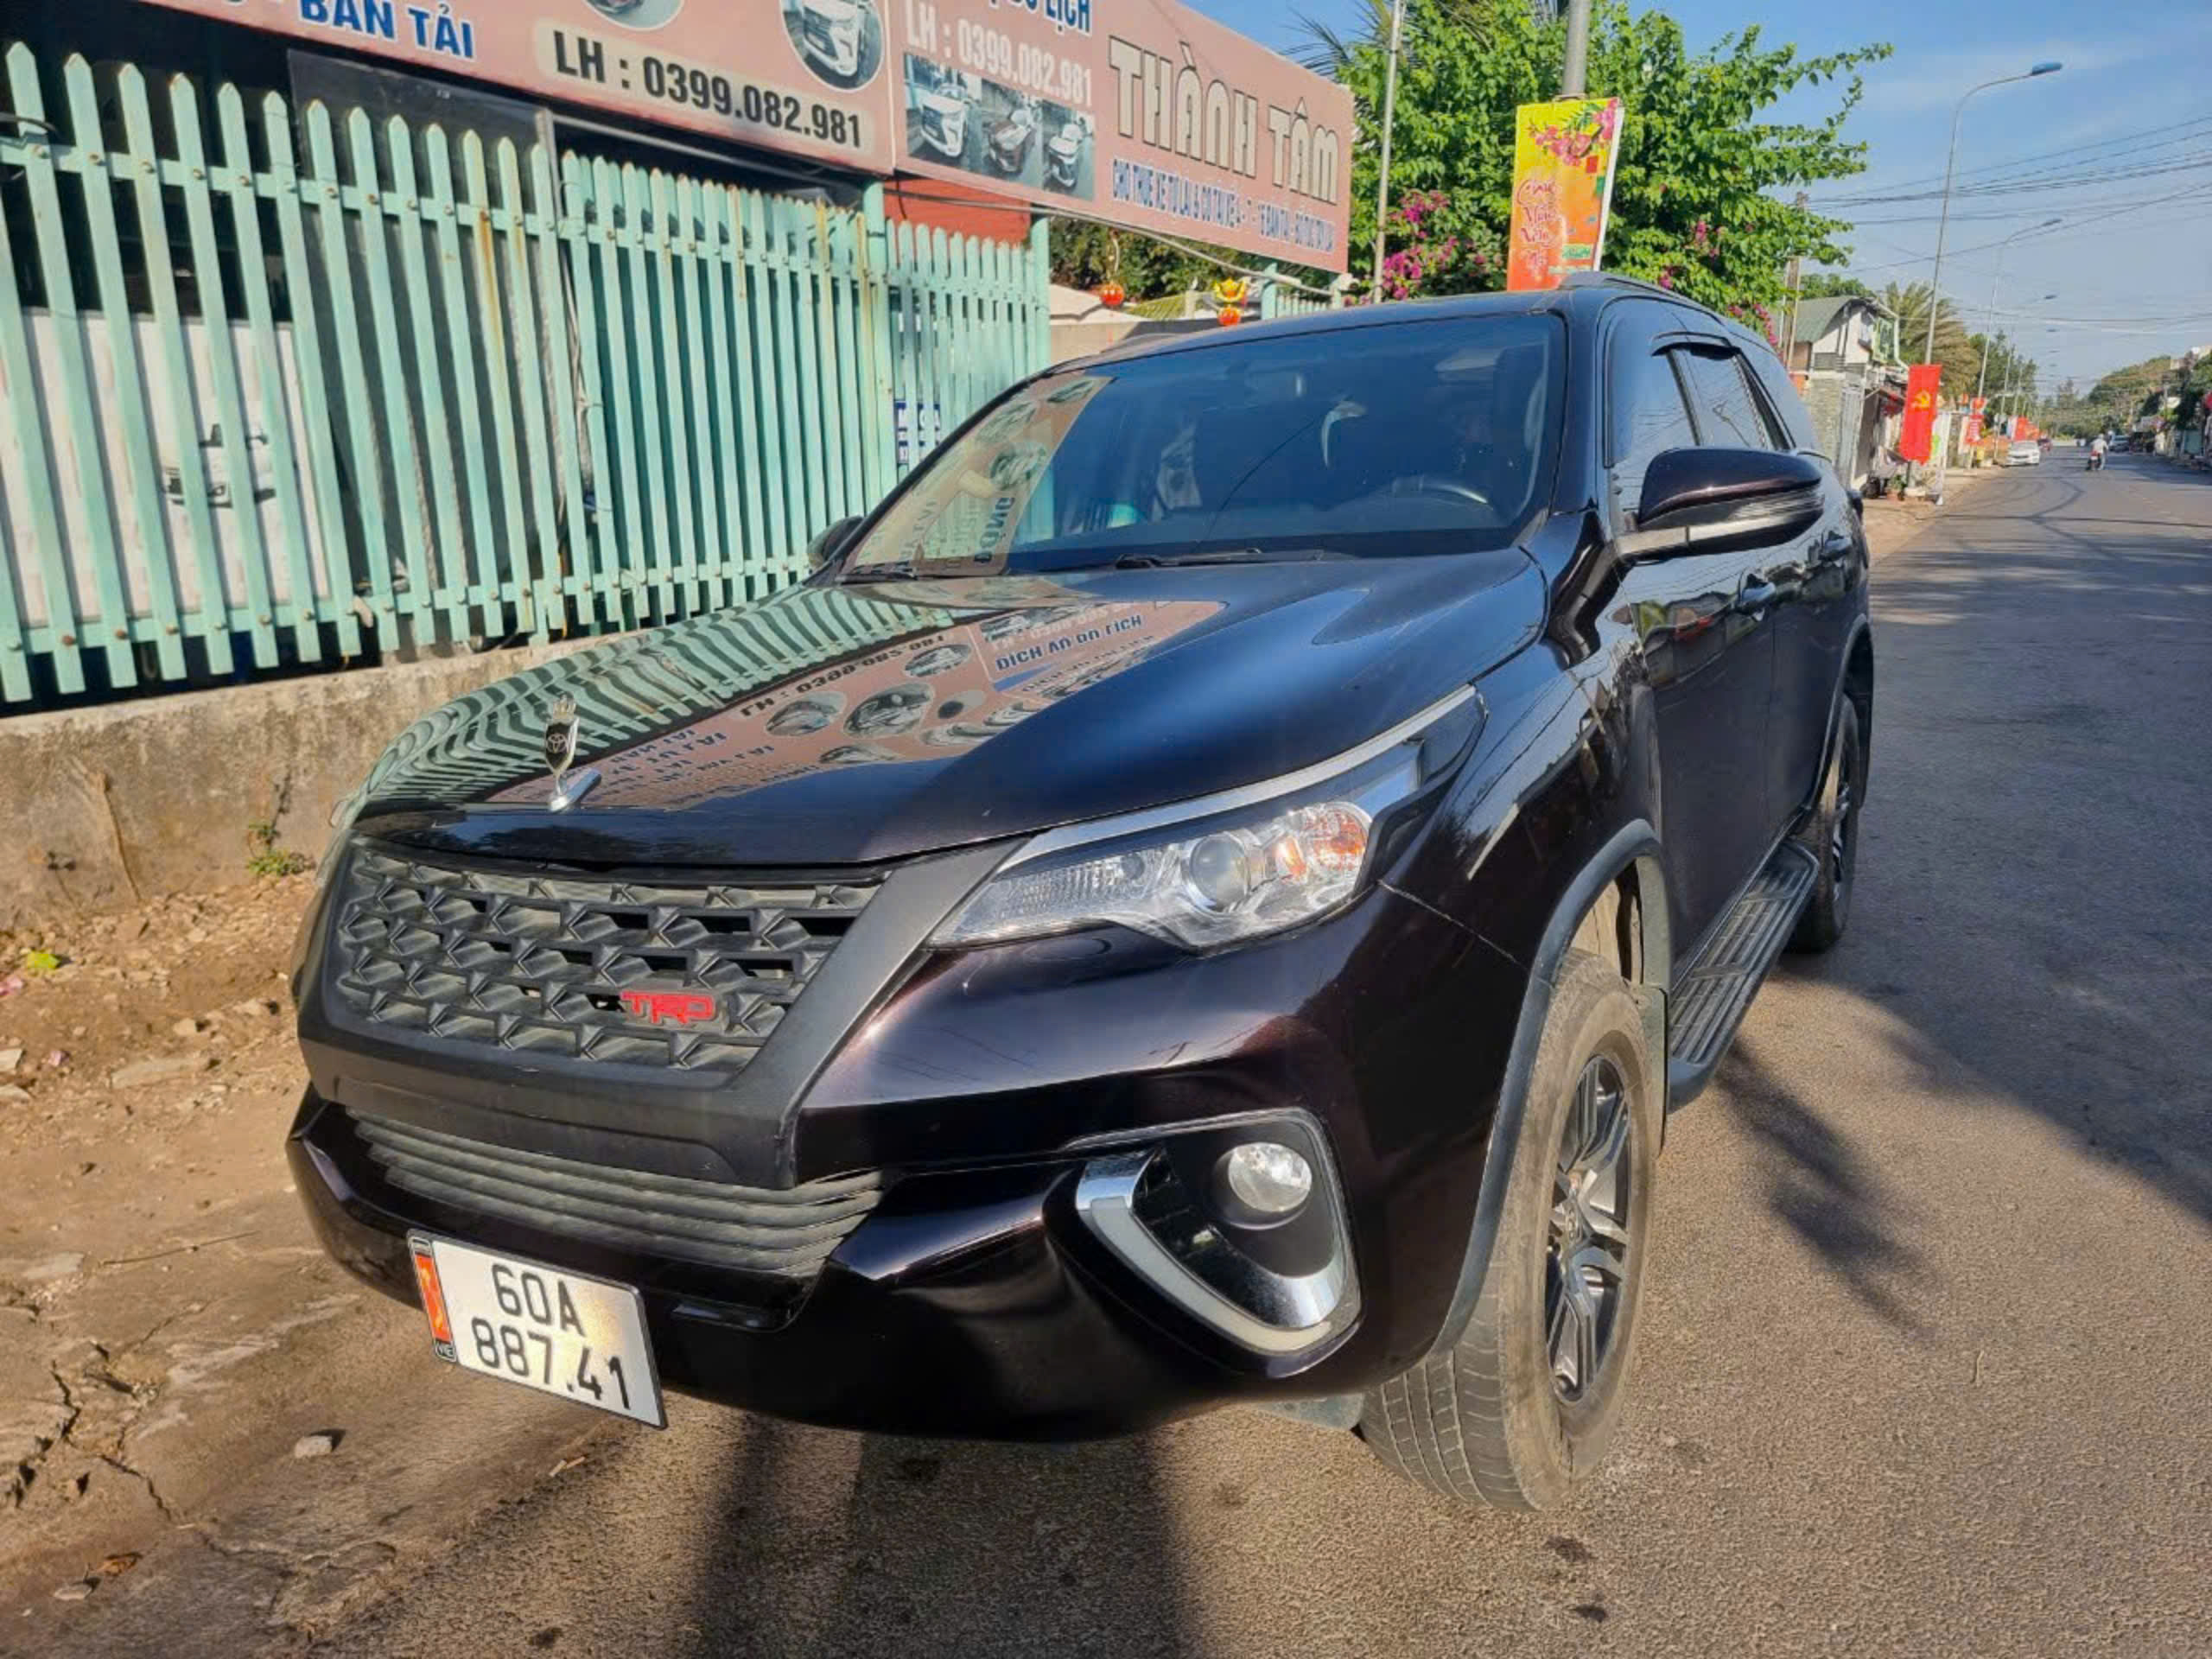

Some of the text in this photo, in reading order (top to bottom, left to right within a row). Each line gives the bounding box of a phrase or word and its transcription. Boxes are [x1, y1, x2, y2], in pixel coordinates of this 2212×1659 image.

[408, 3, 474, 60] TẢI
[906, 0, 938, 54] LH
[957, 18, 1092, 108] 0399.082.981
[553, 29, 606, 84] LH
[642, 55, 861, 149] 0399.082.981
[492, 1263, 586, 1338] 60A
[472, 1316, 631, 1410] 887.41
